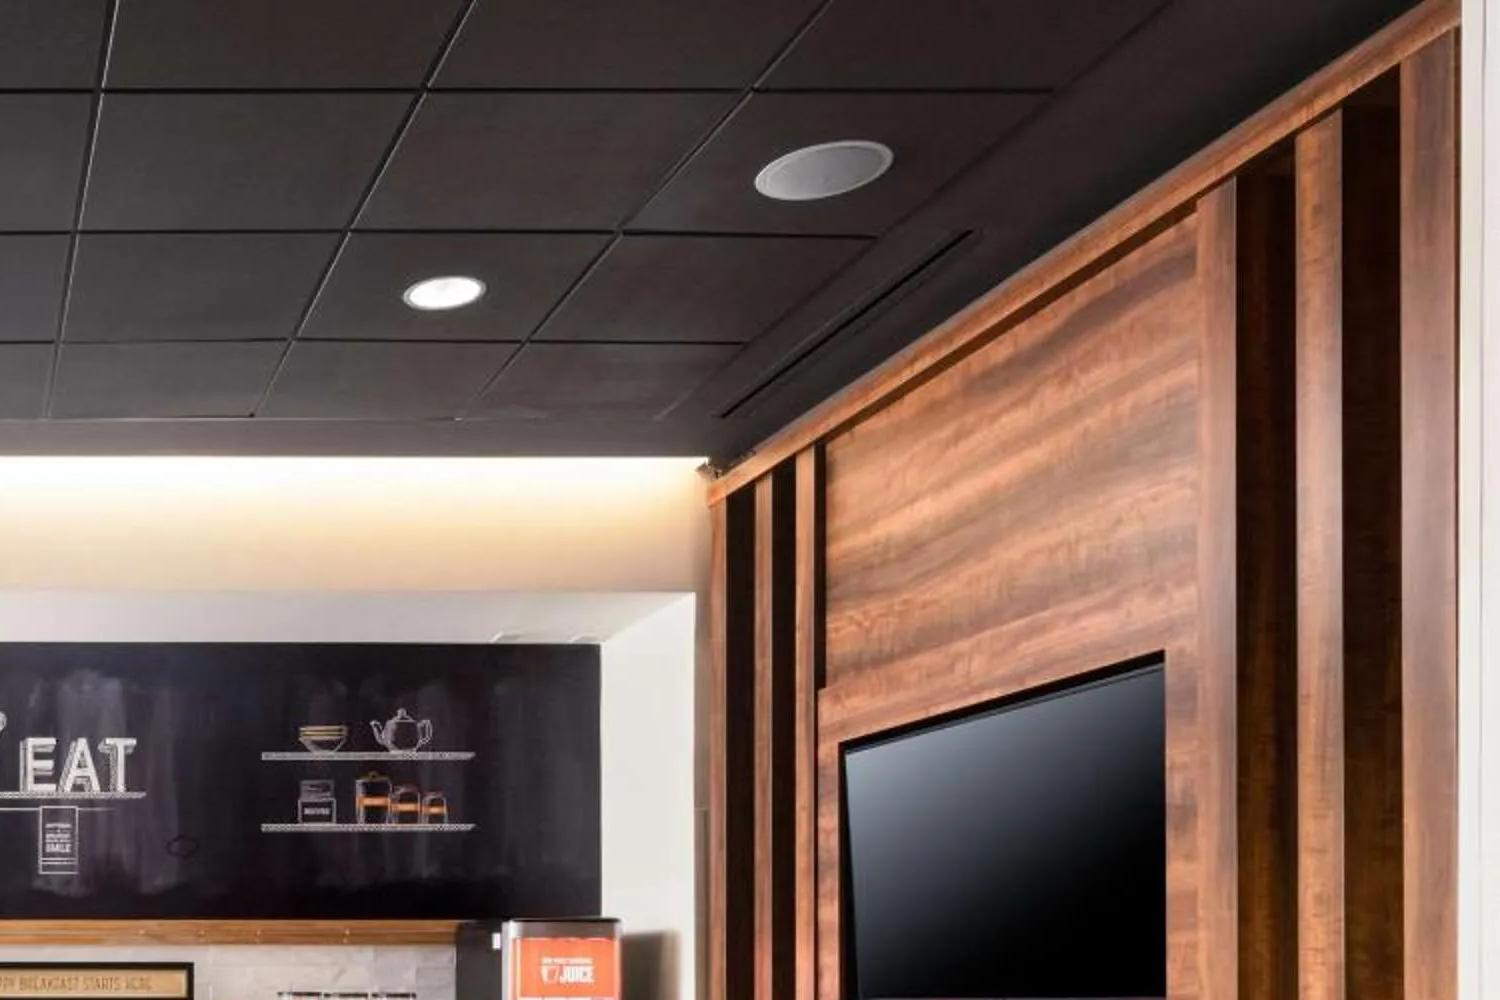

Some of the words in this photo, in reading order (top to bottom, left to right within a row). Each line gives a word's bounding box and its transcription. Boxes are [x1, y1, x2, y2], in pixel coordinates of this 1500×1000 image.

[19, 736, 137, 792] EAT
[19, 975, 79, 991] BREAKFAST
[82, 975, 121, 991] STARTS
[125, 975, 153, 991] HERE
